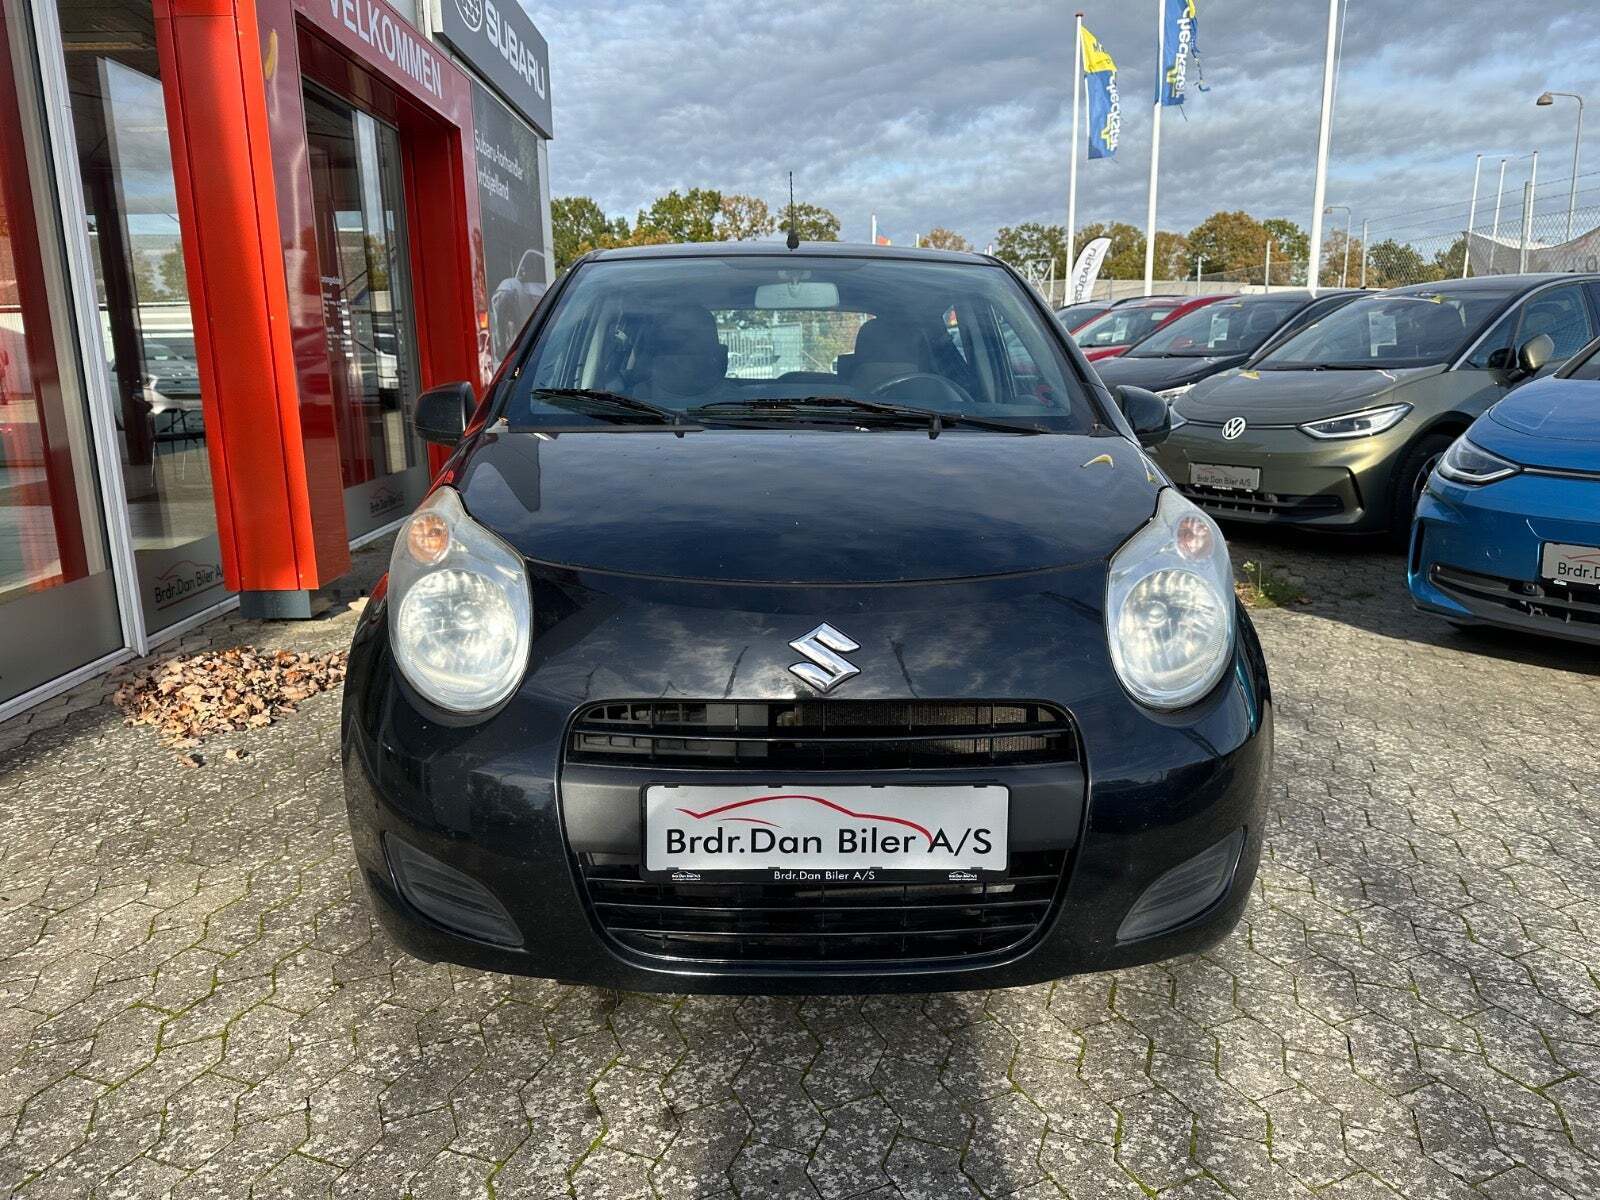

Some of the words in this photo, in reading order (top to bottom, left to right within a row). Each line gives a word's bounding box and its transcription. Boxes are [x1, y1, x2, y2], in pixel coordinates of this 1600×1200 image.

[485, 0, 545, 100] SUBARU
[1074, 247, 1097, 302] SUBARU
[666, 828, 822, 854] Brdr.Dan
[838, 828, 917, 854] Biler
[928, 828, 992, 856] A/S
[774, 870, 821, 880] Brdr.Dan
[825, 871, 849, 880] Biler
[853, 871, 875, 881] A/S
